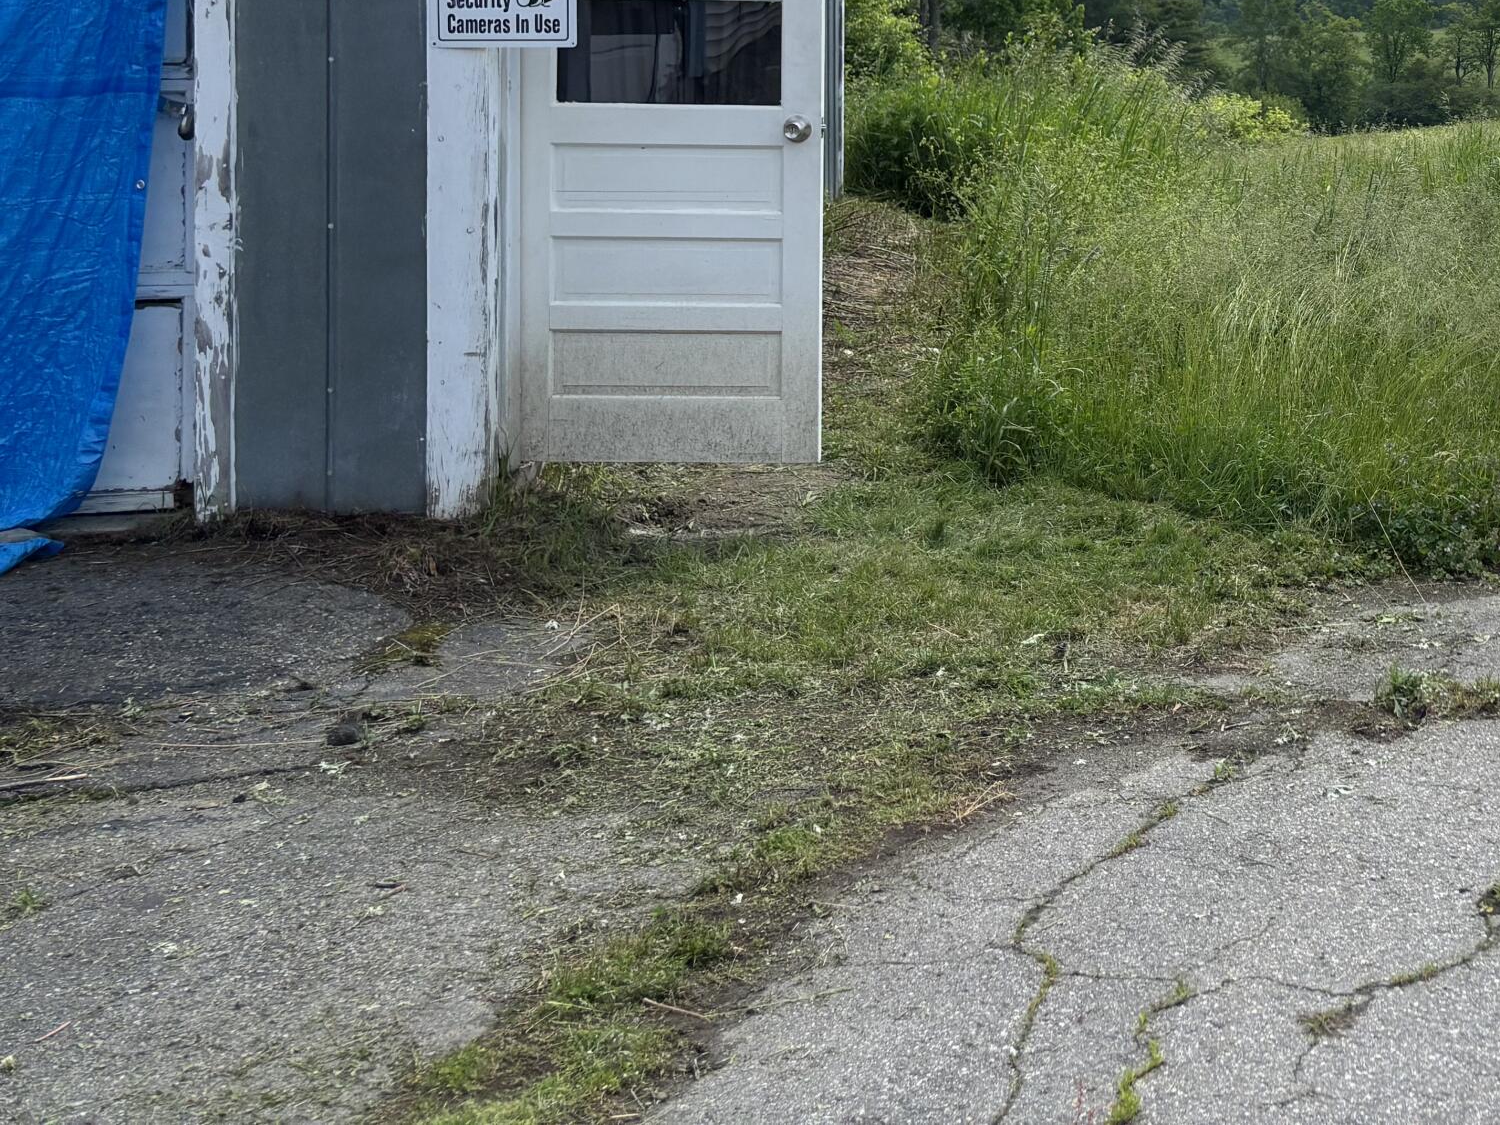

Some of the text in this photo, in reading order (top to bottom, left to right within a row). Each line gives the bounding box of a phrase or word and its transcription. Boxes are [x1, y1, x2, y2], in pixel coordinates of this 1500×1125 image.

[447, 13, 561, 34] Cameras In Use
